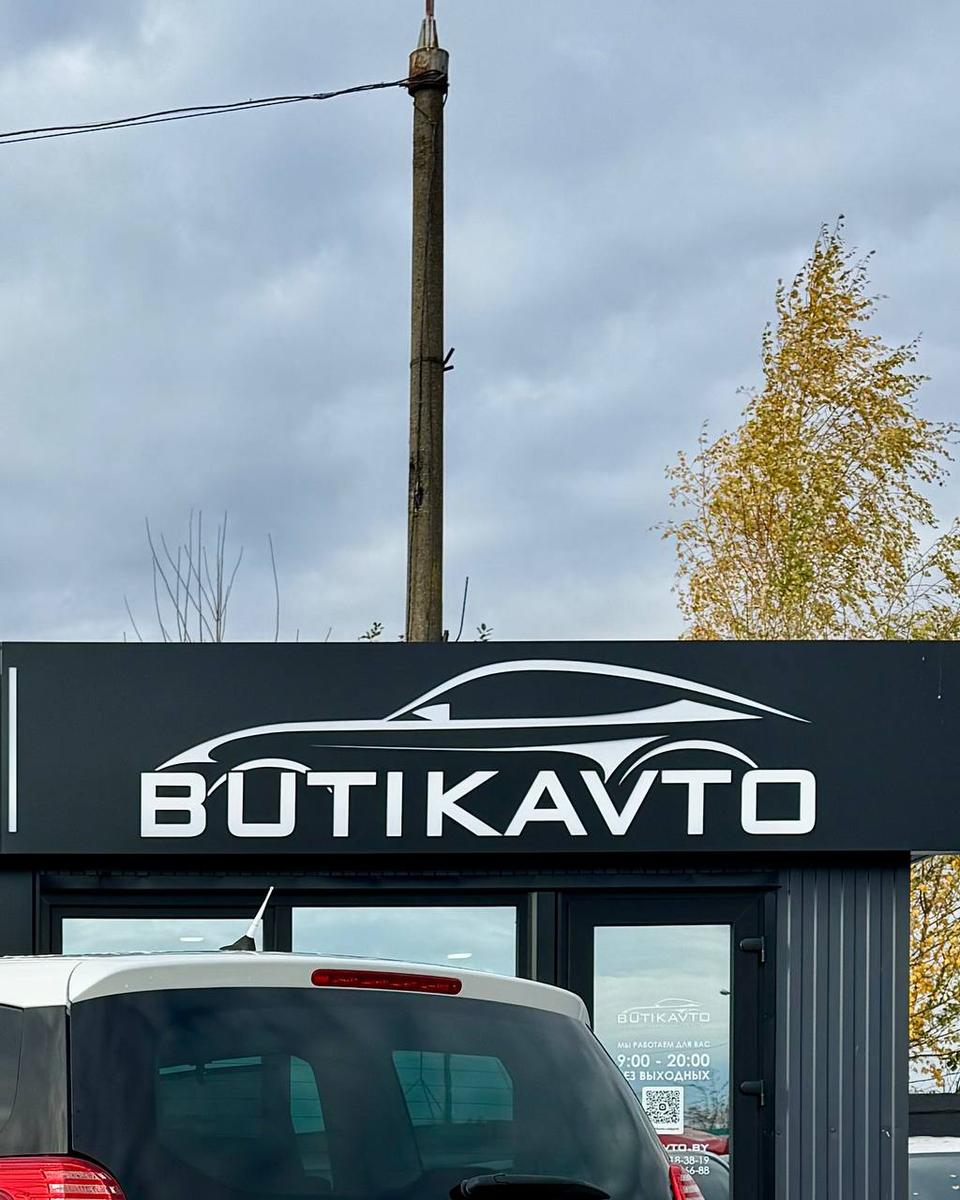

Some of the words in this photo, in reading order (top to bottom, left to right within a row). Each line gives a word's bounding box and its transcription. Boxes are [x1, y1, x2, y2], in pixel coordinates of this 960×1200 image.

[140, 768, 816, 838] BUTIKAVTO
[617, 1012, 711, 1023] BUTIKAVTO
[617, 1054, 650, 1067] 9:00
[667, 1053, 710, 1067] 20:00
[624, 1071, 635, 1080] ЕЗ
[640, 1070, 710, 1081] ВЫХОДНЫХ
[663, 1143, 709, 1151] VTO.BY
[670, 1156, 710, 1165] 18-38-19
